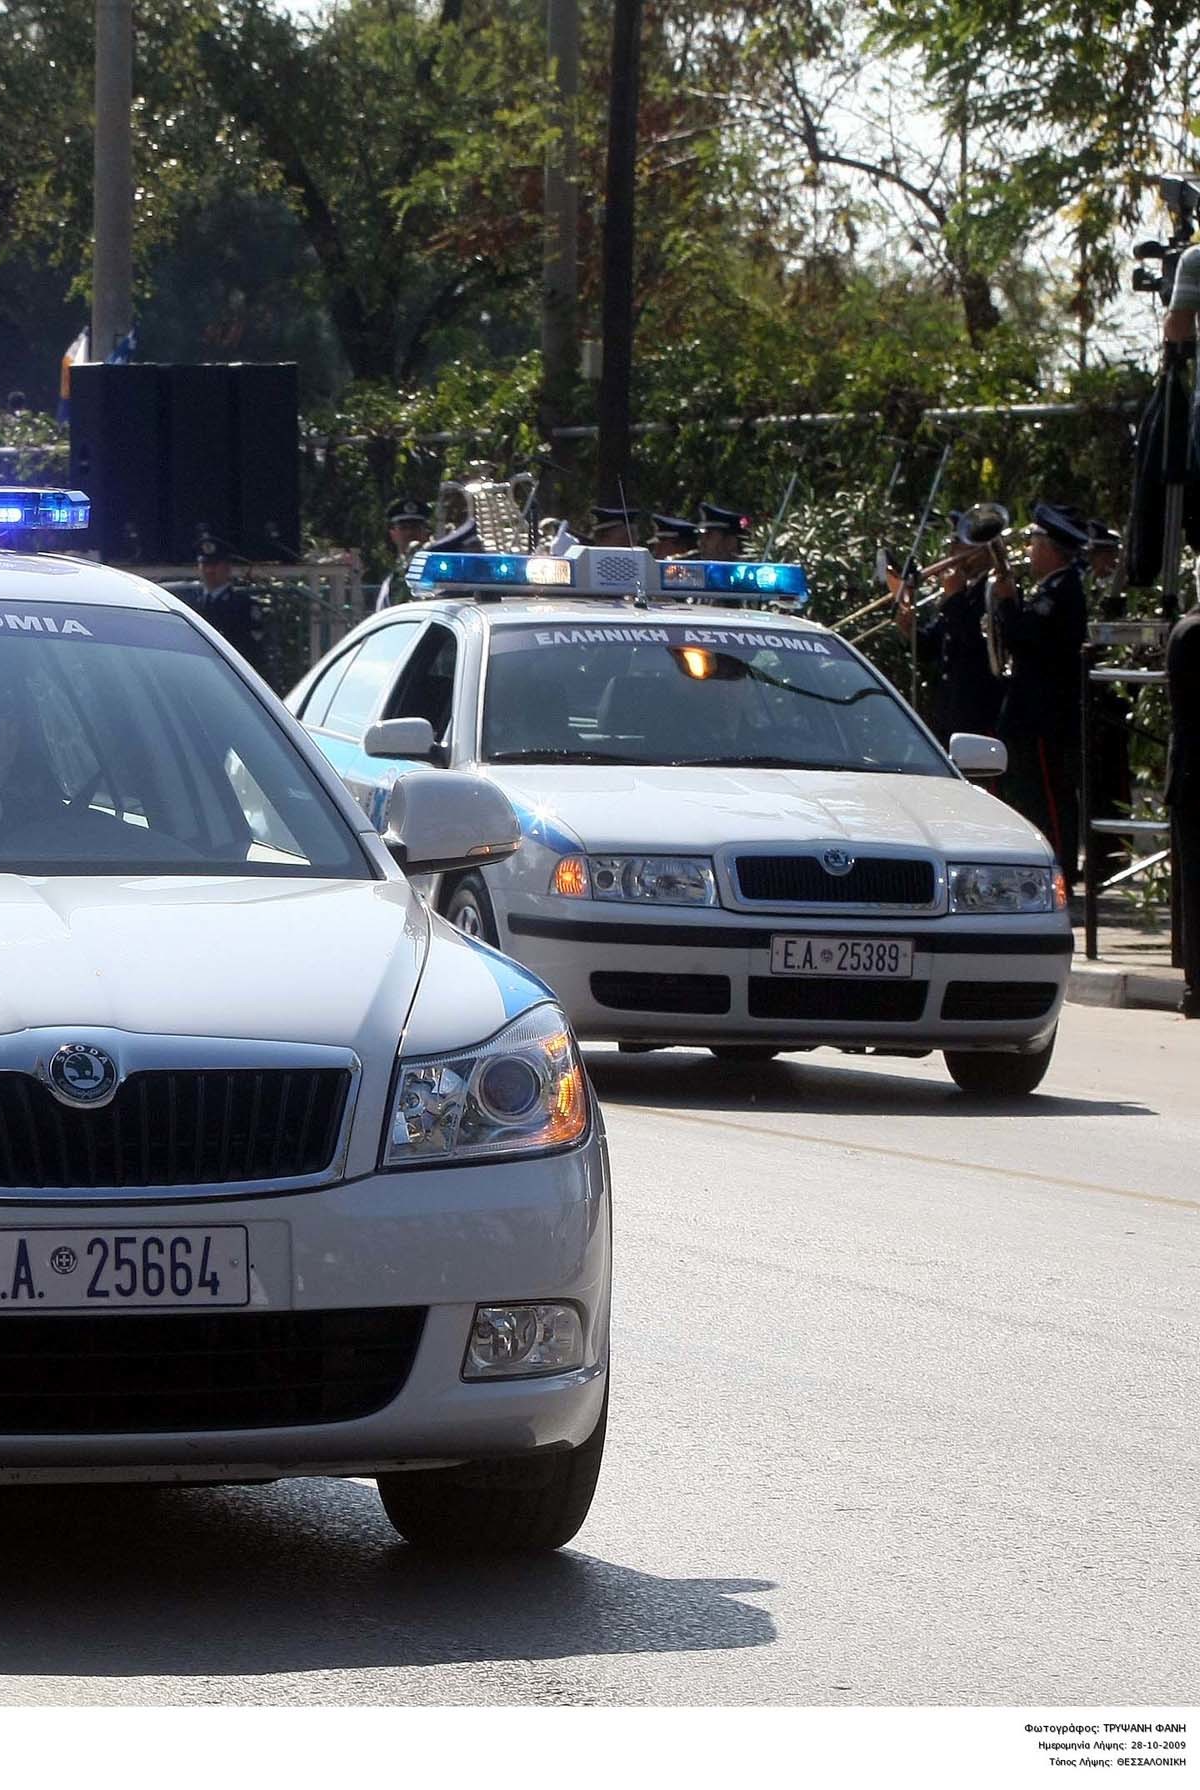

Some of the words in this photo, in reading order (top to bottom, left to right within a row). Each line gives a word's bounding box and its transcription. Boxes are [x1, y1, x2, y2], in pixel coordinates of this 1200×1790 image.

[535, 629, 669, 646] ΕΛΛΗΝΙΚΗ
[684, 629, 830, 655] ΑΣΤΥΝΟΜΙΑ
[836, 942, 899, 972] 25389
[86, 1236, 220, 1298] 25664
